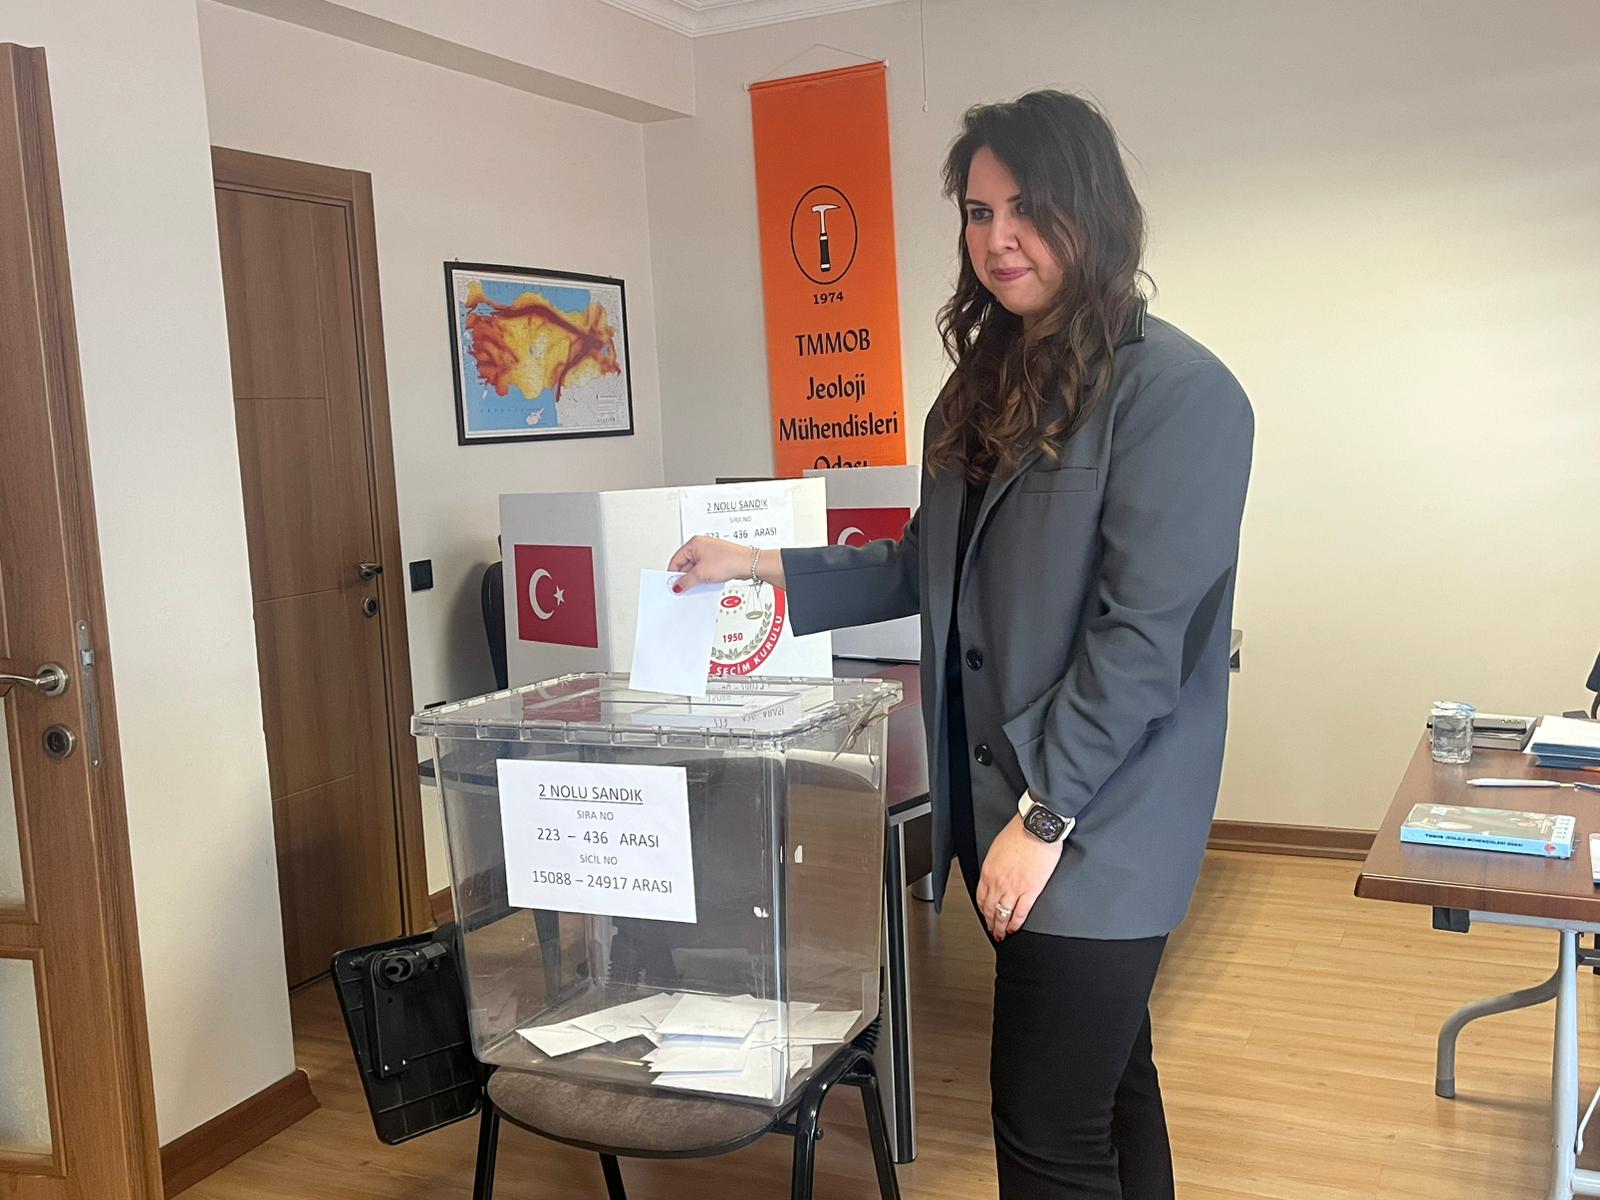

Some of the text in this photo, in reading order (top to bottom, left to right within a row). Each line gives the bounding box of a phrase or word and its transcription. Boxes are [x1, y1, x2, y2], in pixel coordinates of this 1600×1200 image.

[813, 291, 845, 305] 1974
[795, 328, 871, 356] TMMOB
[806, 373, 865, 403] Jeoloji
[780, 411, 898, 441] Mühendisleri
[706, 499, 768, 511] 2 NOLU SANDIK
[733, 529, 748, 539] 436
[754, 527, 777, 537] ARASI
[722, 632, 743, 643] 1950
[753, 615, 783, 665] KURULU
[538, 784, 643, 802] 2 NOLU SANDIK
[576, 810, 614, 821] SIRA NO
[537, 827, 561, 841] 223
[583, 830, 609, 844] 436
[619, 833, 660, 848] ARASI
[579, 854, 618, 866] SİCİL NO
[532, 870, 572, 886] 15088
[587, 874, 628, 890] 24917
[632, 878, 672, 893] ARASI
